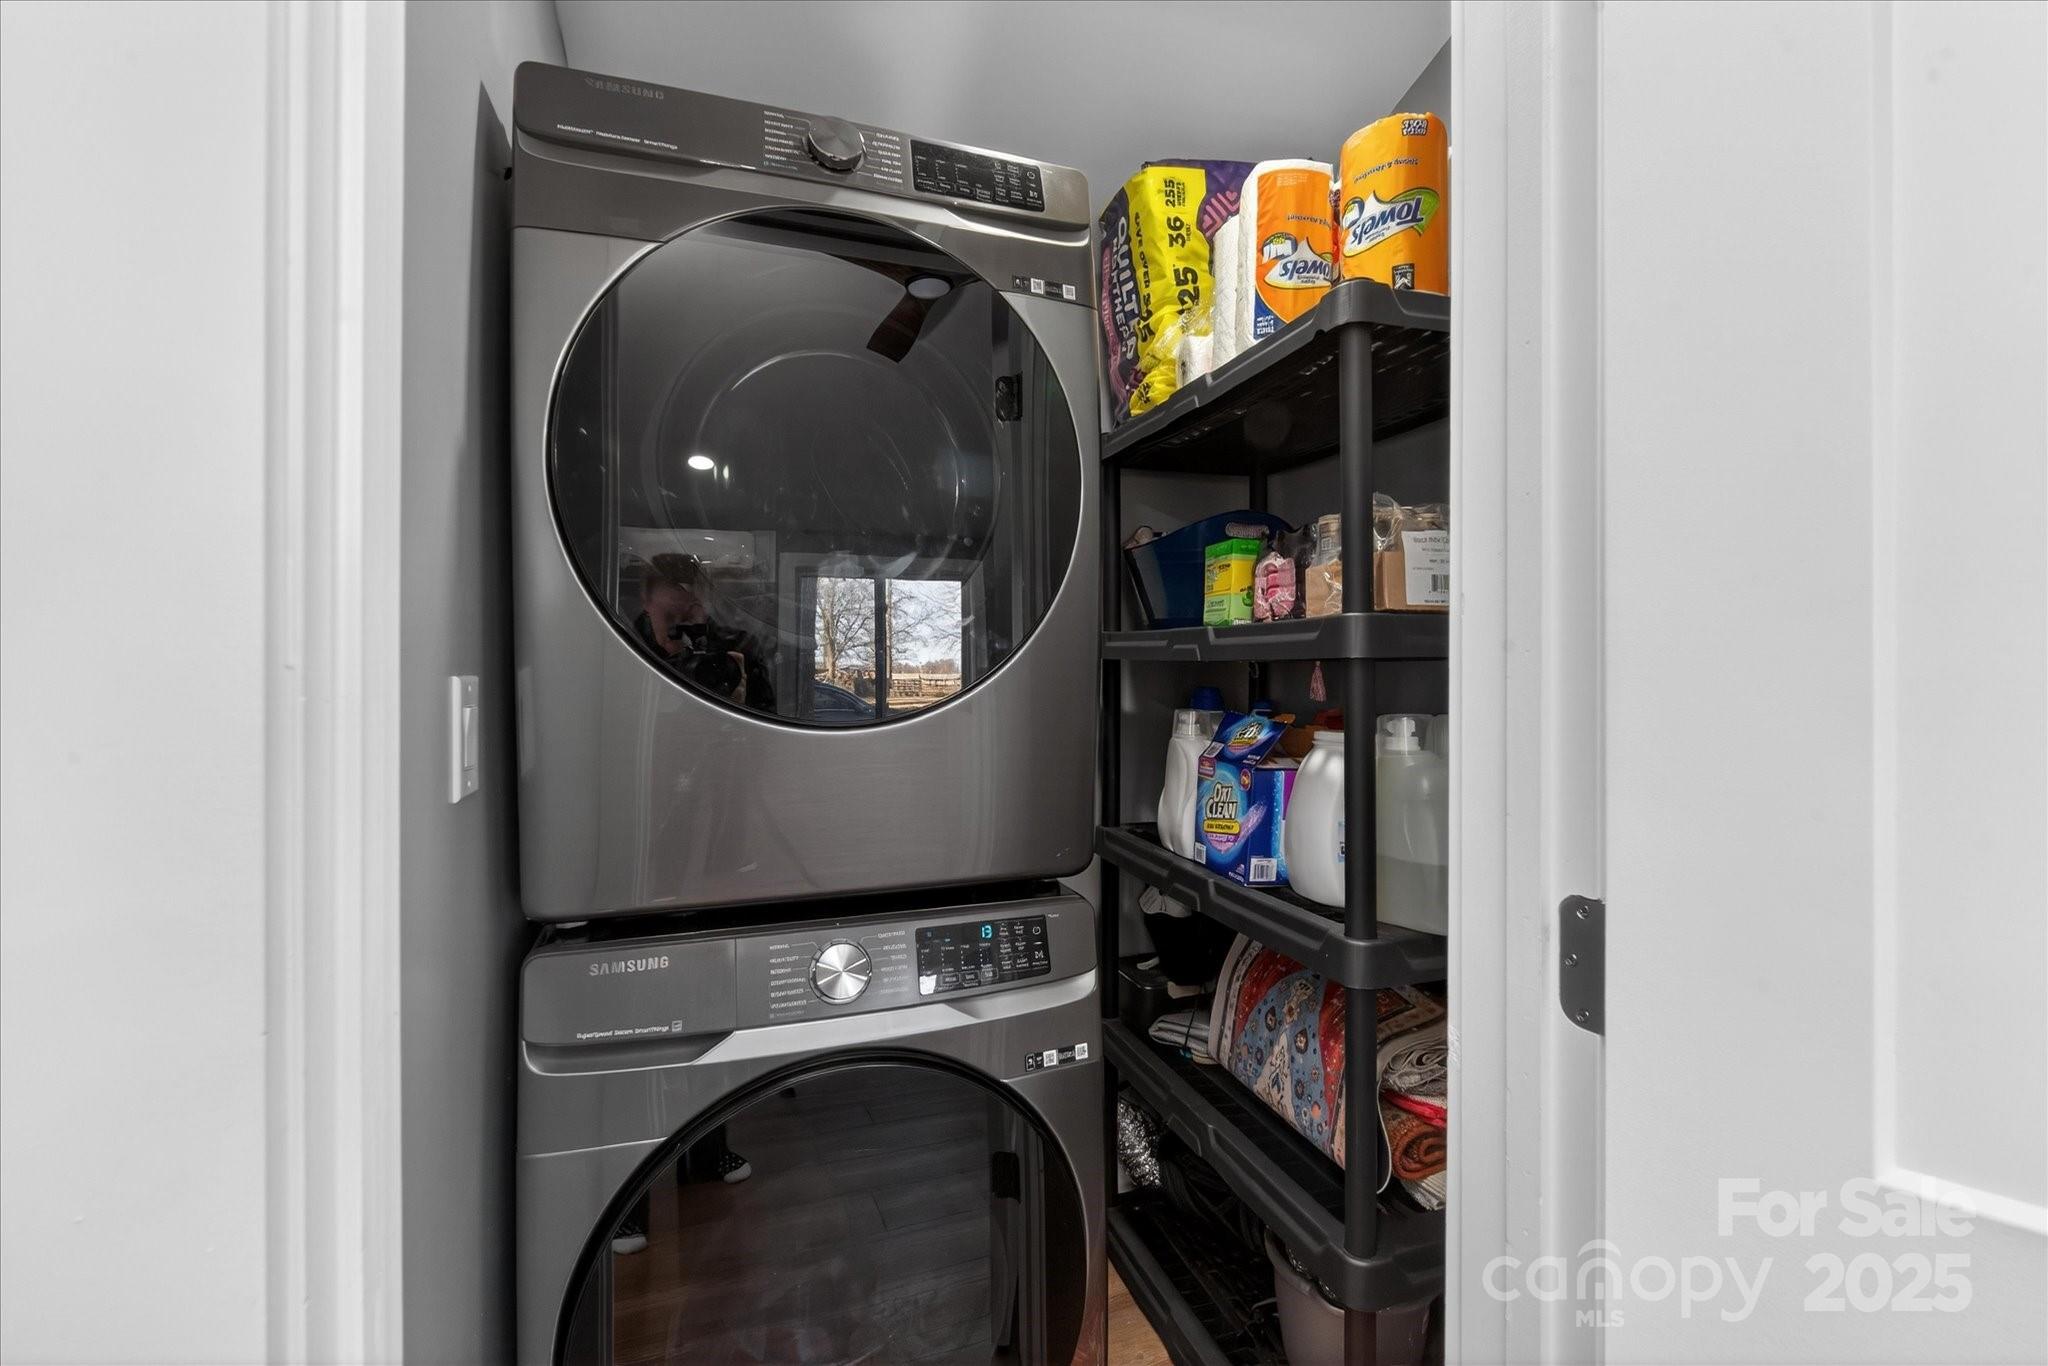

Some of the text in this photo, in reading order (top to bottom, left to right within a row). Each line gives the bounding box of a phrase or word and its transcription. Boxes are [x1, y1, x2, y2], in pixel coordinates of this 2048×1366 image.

[584, 77, 664, 100] SAMSUNG
[1164, 178, 1177, 208] 255
[1351, 195, 1424, 245] Towels
[1168, 215, 1186, 249] 36
[1213, 783, 1233, 803] OXI
[1206, 798, 1237, 819] CLEAN
[589, 956, 669, 977] SAMSUNG
